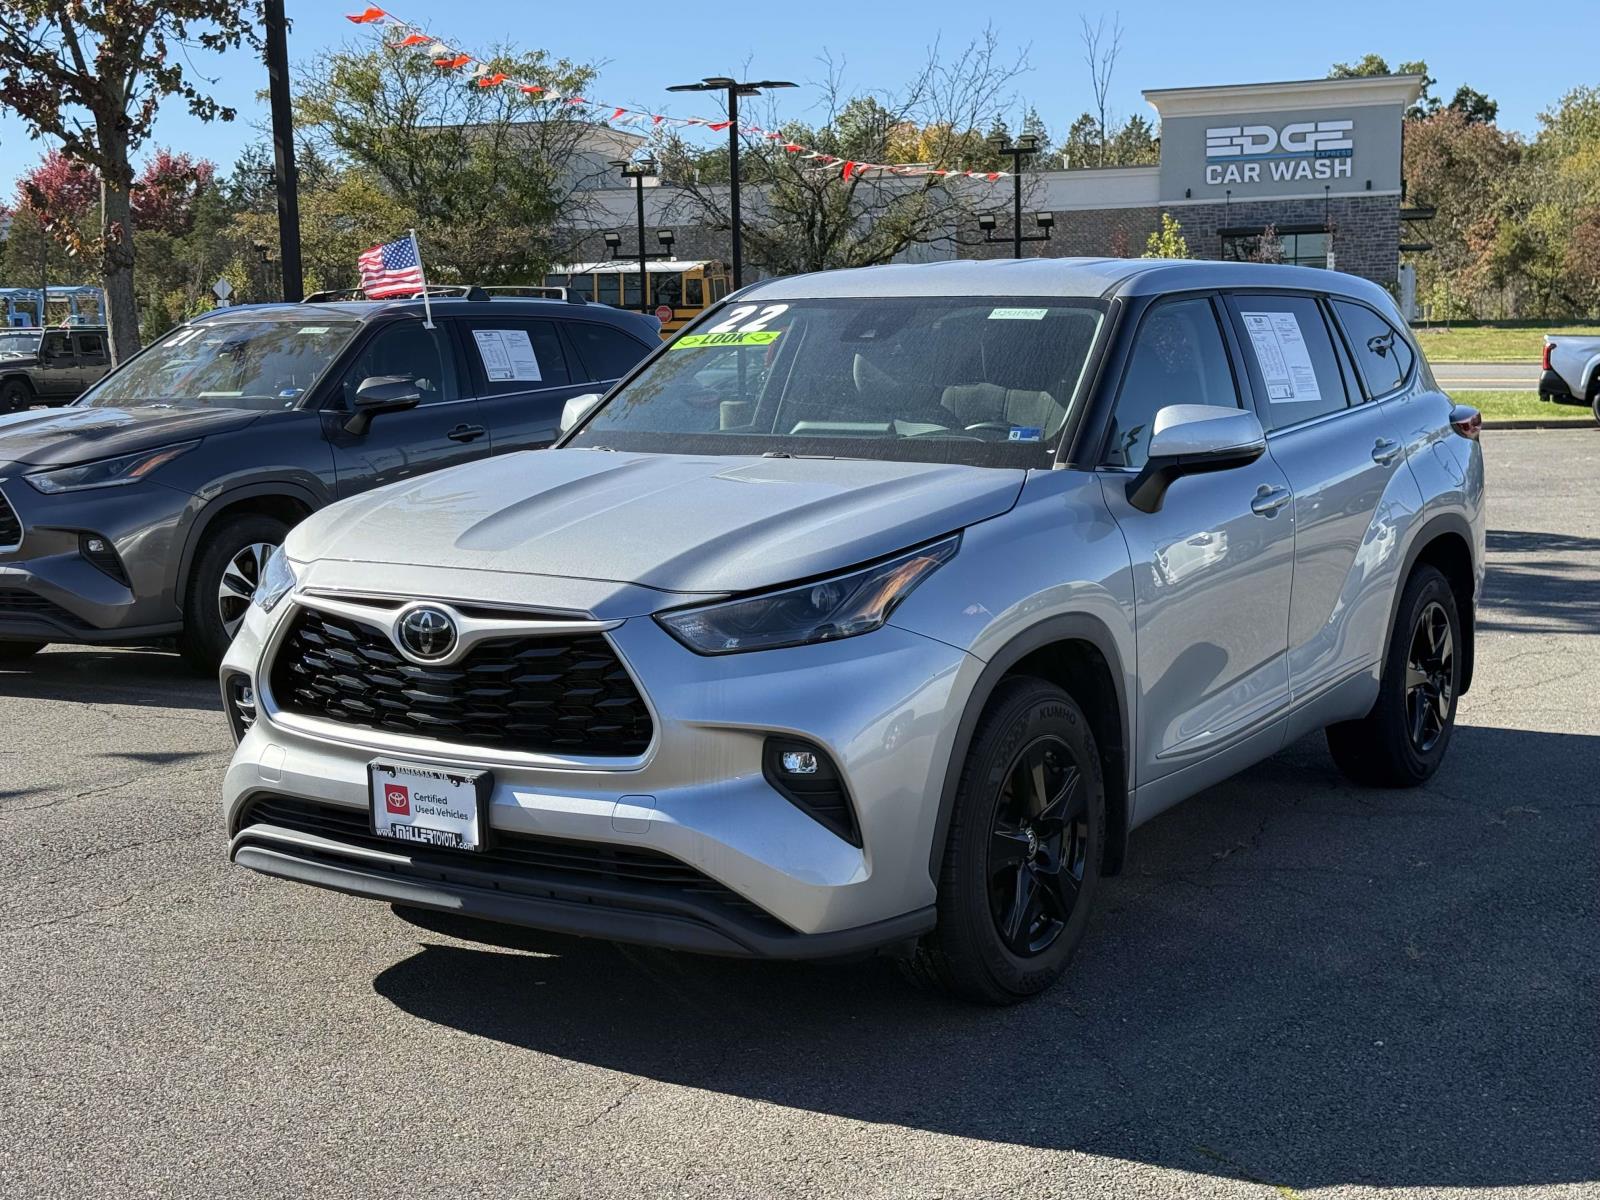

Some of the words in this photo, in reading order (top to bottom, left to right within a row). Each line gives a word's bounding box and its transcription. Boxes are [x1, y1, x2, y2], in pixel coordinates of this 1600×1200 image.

[1206, 120, 1353, 157] EDGE
[1206, 163, 1260, 185] CAR
[1270, 158, 1352, 182] WASH
[708, 304, 789, 333] 22
[700, 333, 748, 345] LOOK
[1039, 705, 1077, 726] KUMHO
[413, 792, 448, 805] Certified
[415, 804, 435, 816] Used
[436, 807, 469, 820] Vehicles
